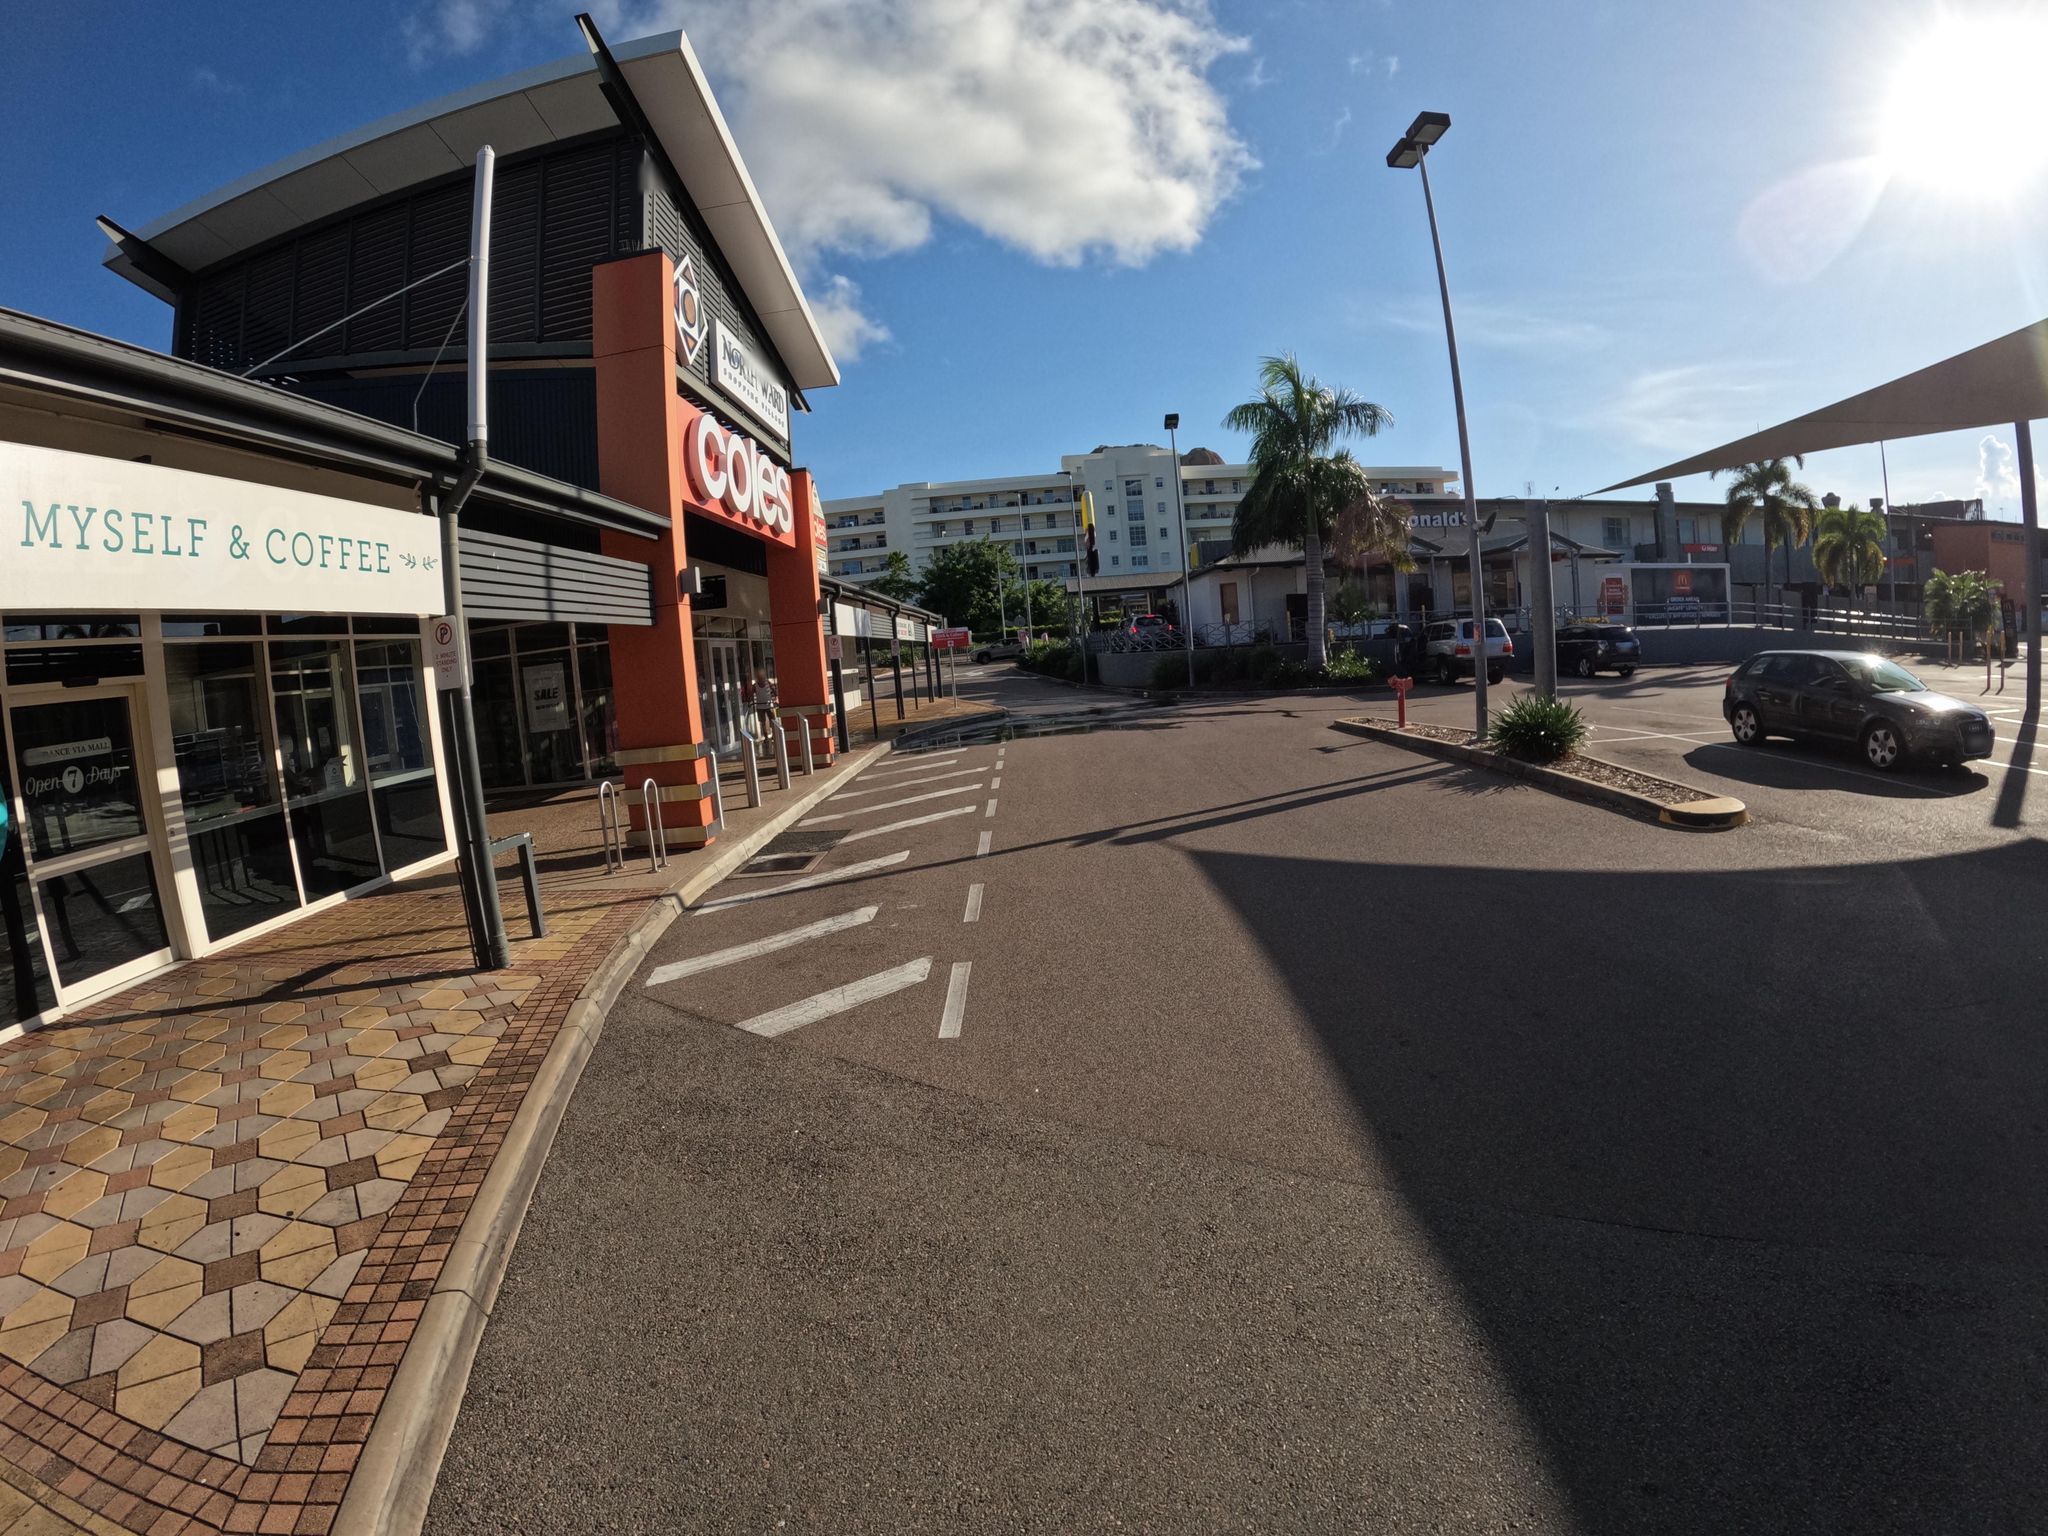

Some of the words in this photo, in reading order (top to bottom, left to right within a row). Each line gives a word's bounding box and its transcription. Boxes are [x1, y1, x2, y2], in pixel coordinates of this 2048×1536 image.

[761, 381, 785, 414] WARD
[697, 413, 793, 534] coles
[1408, 511, 1468, 528] onald's
[20, 500, 207, 557] MYSELF
[229, 524, 250, 561] &
[265, 528, 391, 574] COFFEE
[534, 687, 559, 700] SALE
[72, 745, 86, 753] VIA
[88, 742, 110, 752] MALL
[25, 776, 61, 798] Open
[67, 769, 78, 789] 7
[85, 766, 120, 785] Days
